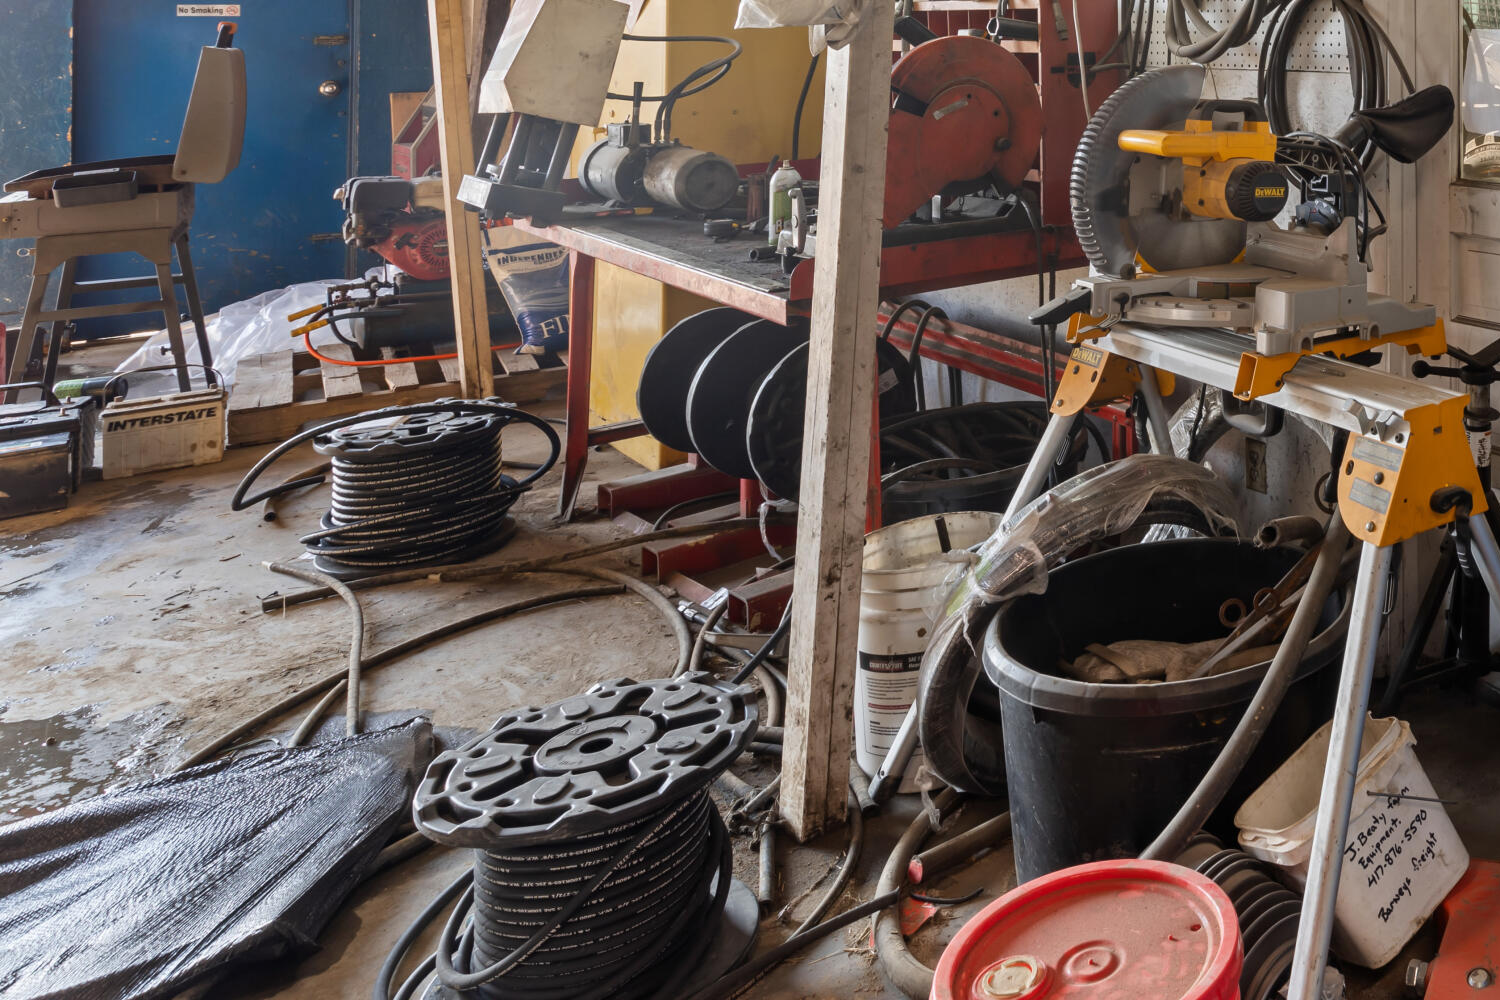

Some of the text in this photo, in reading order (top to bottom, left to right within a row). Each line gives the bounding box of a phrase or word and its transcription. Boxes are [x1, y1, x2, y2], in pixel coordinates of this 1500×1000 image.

[191, 7, 223, 15] Smoking
[1255, 187, 1285, 197] DeWALT
[107, 407, 217, 432] INTERSTATE
[1367, 809, 1428, 888] 417-876-5590
